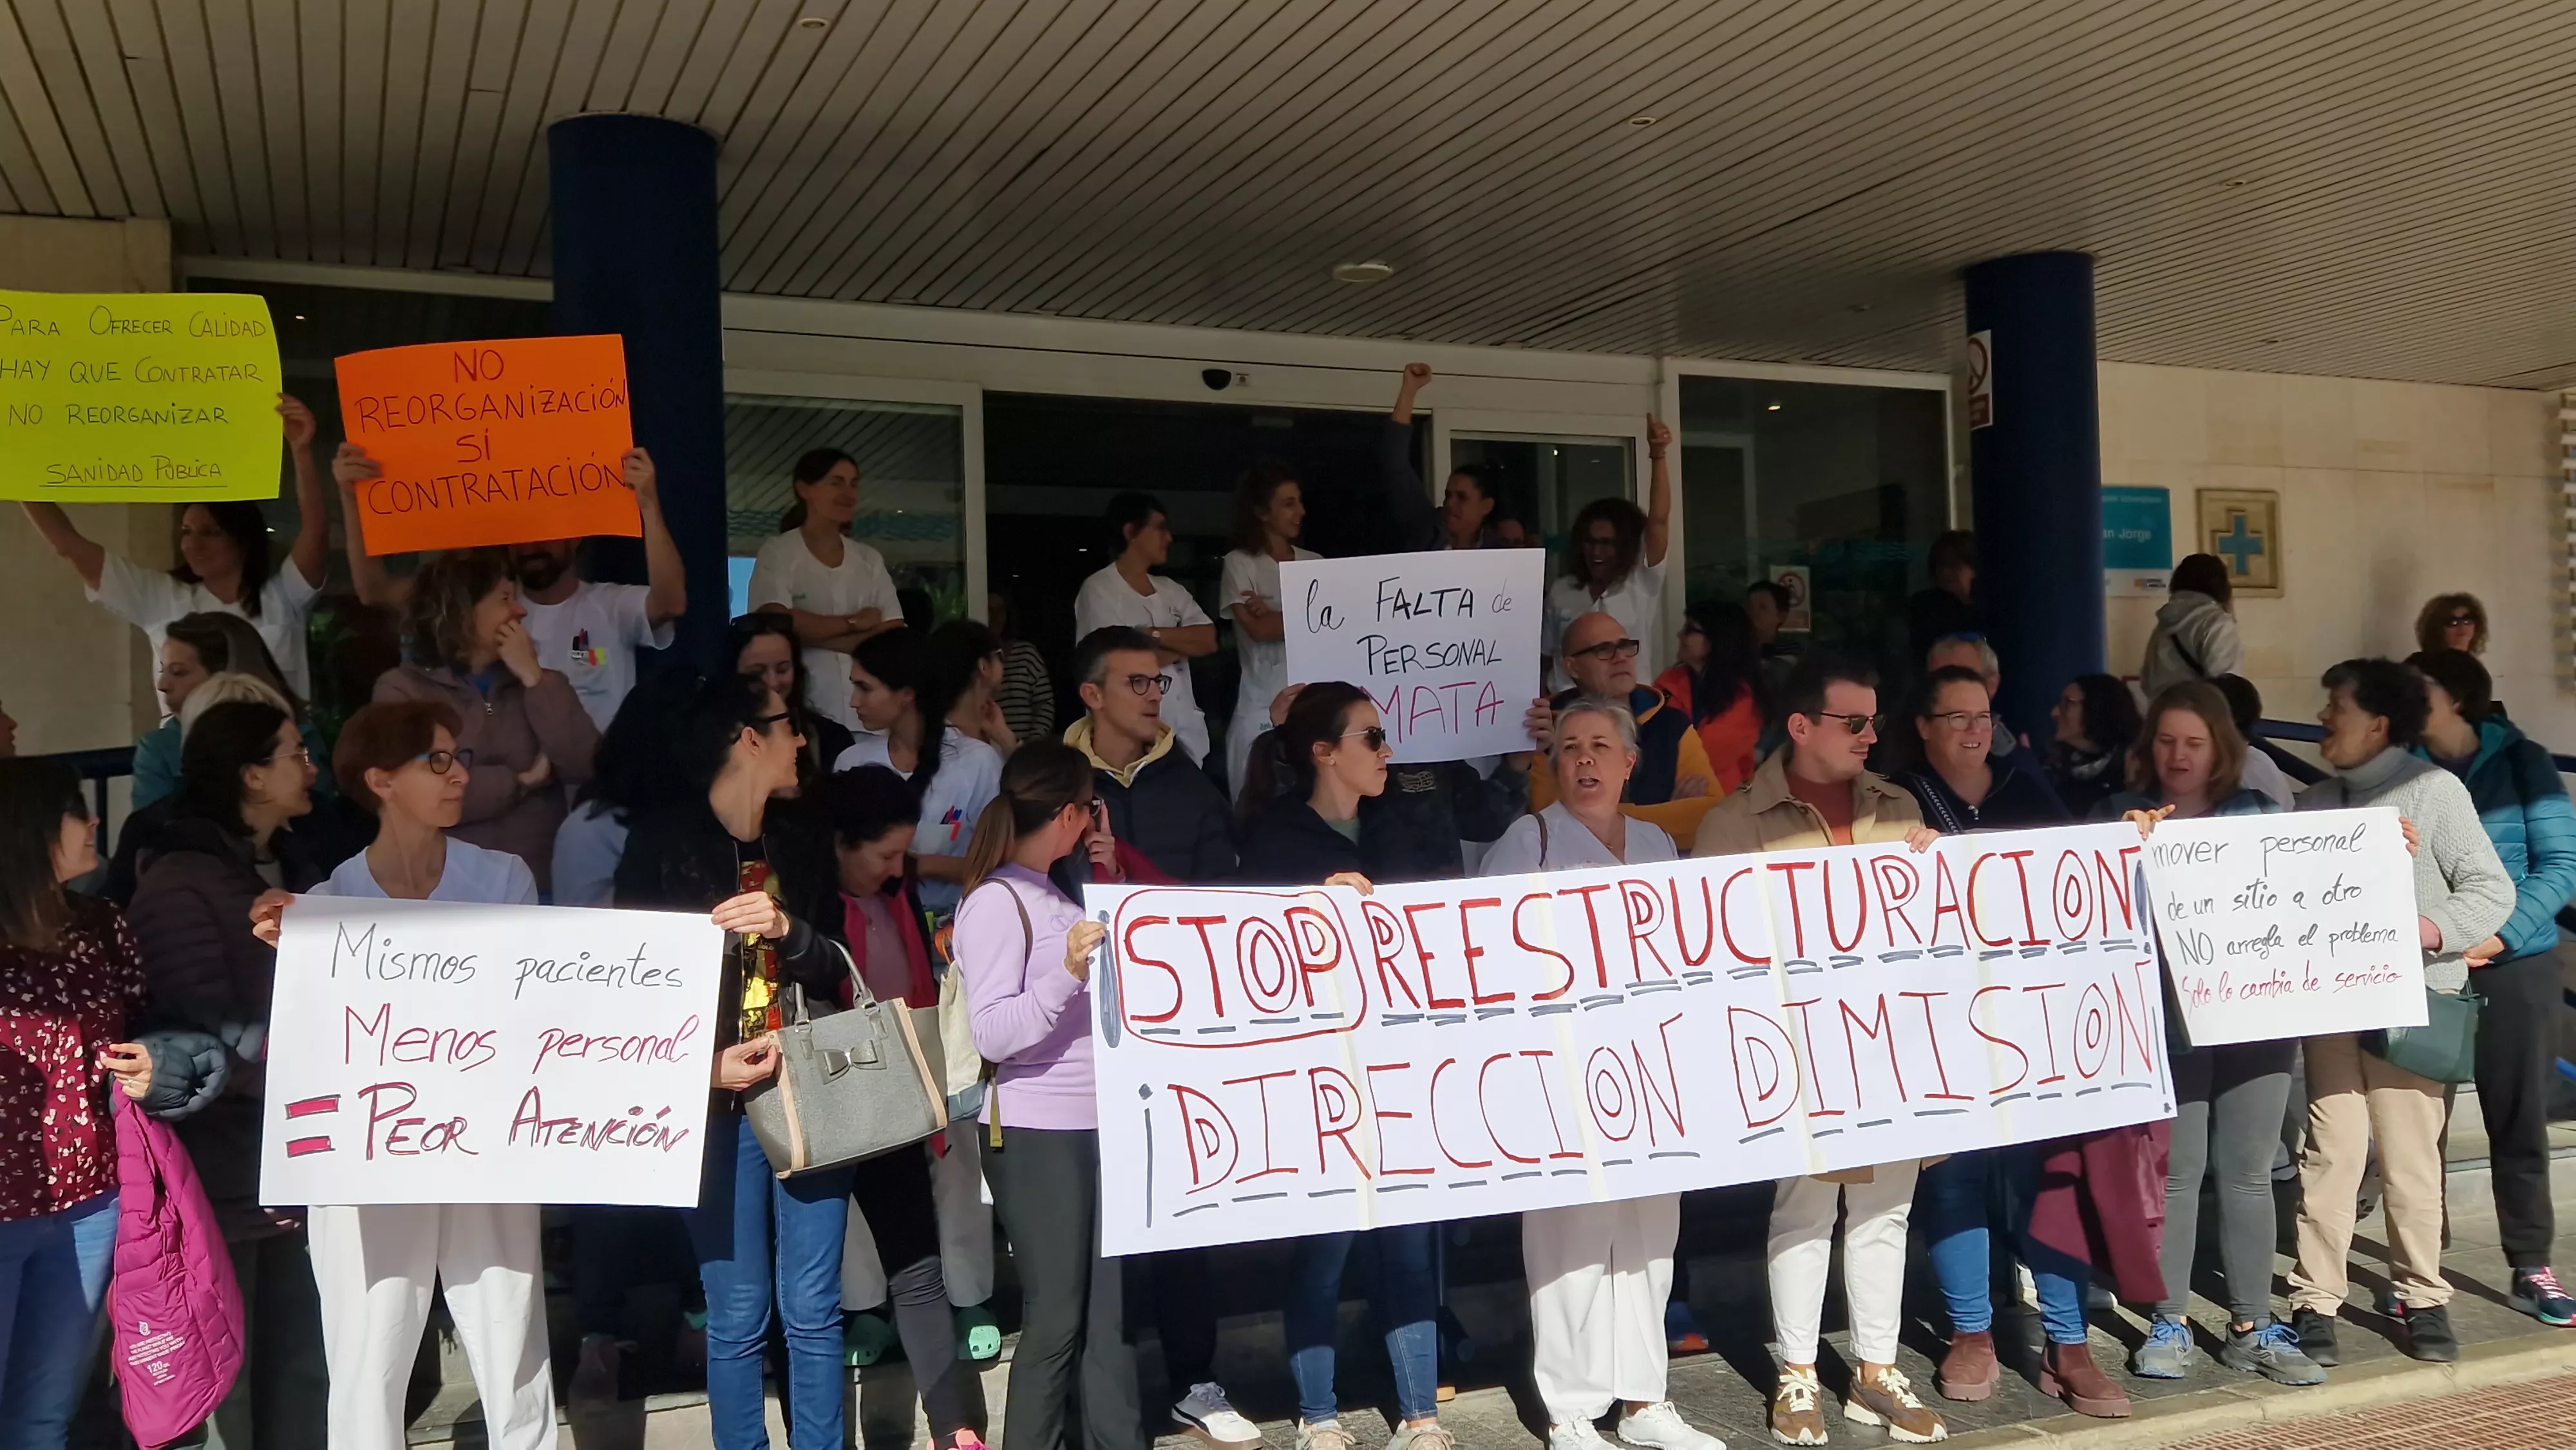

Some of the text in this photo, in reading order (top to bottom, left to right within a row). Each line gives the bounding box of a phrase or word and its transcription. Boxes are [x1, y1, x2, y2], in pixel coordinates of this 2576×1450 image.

[90, 305, 173, 335] OFRECER
[189, 311, 266, 337] CALIDAD
[0, 356, 263, 384] HAY QUE CONTRATAR
[453, 348, 504, 383] NO
[8, 402, 229, 427] NO REORGANIZAR
[354, 377, 627, 433] REORGANIZACIÓN
[46, 457, 143, 484] SANIDAD
[1376, 576, 1475, 623] FALTA
[1492, 578, 1512, 614] de
[1356, 634, 1502, 675] PERSONAL
[1359, 680, 1505, 744] MATA
[2152, 822, 2367, 878] mover personal
[2168, 872, 2362, 921] de un sitio a otro
[330, 921, 683, 1000] Mismos pacientes
[2175, 921, 2399, 966] NO arregla el problema
[2219, 970, 2233, 1003] lo
[2239, 968, 2295, 1000] cambia
[2302, 959, 2320, 992] de
[2333, 964, 2403, 994] servicio
[345, 1003, 700, 1074] Menos personal
[1727, 959, 2173, 1129] DIMISION!
[358, 1081, 479, 1161] PEOR
[508, 1085, 690, 1153] ATENCIÓN
[147, 1361, 163, 1373] 120
